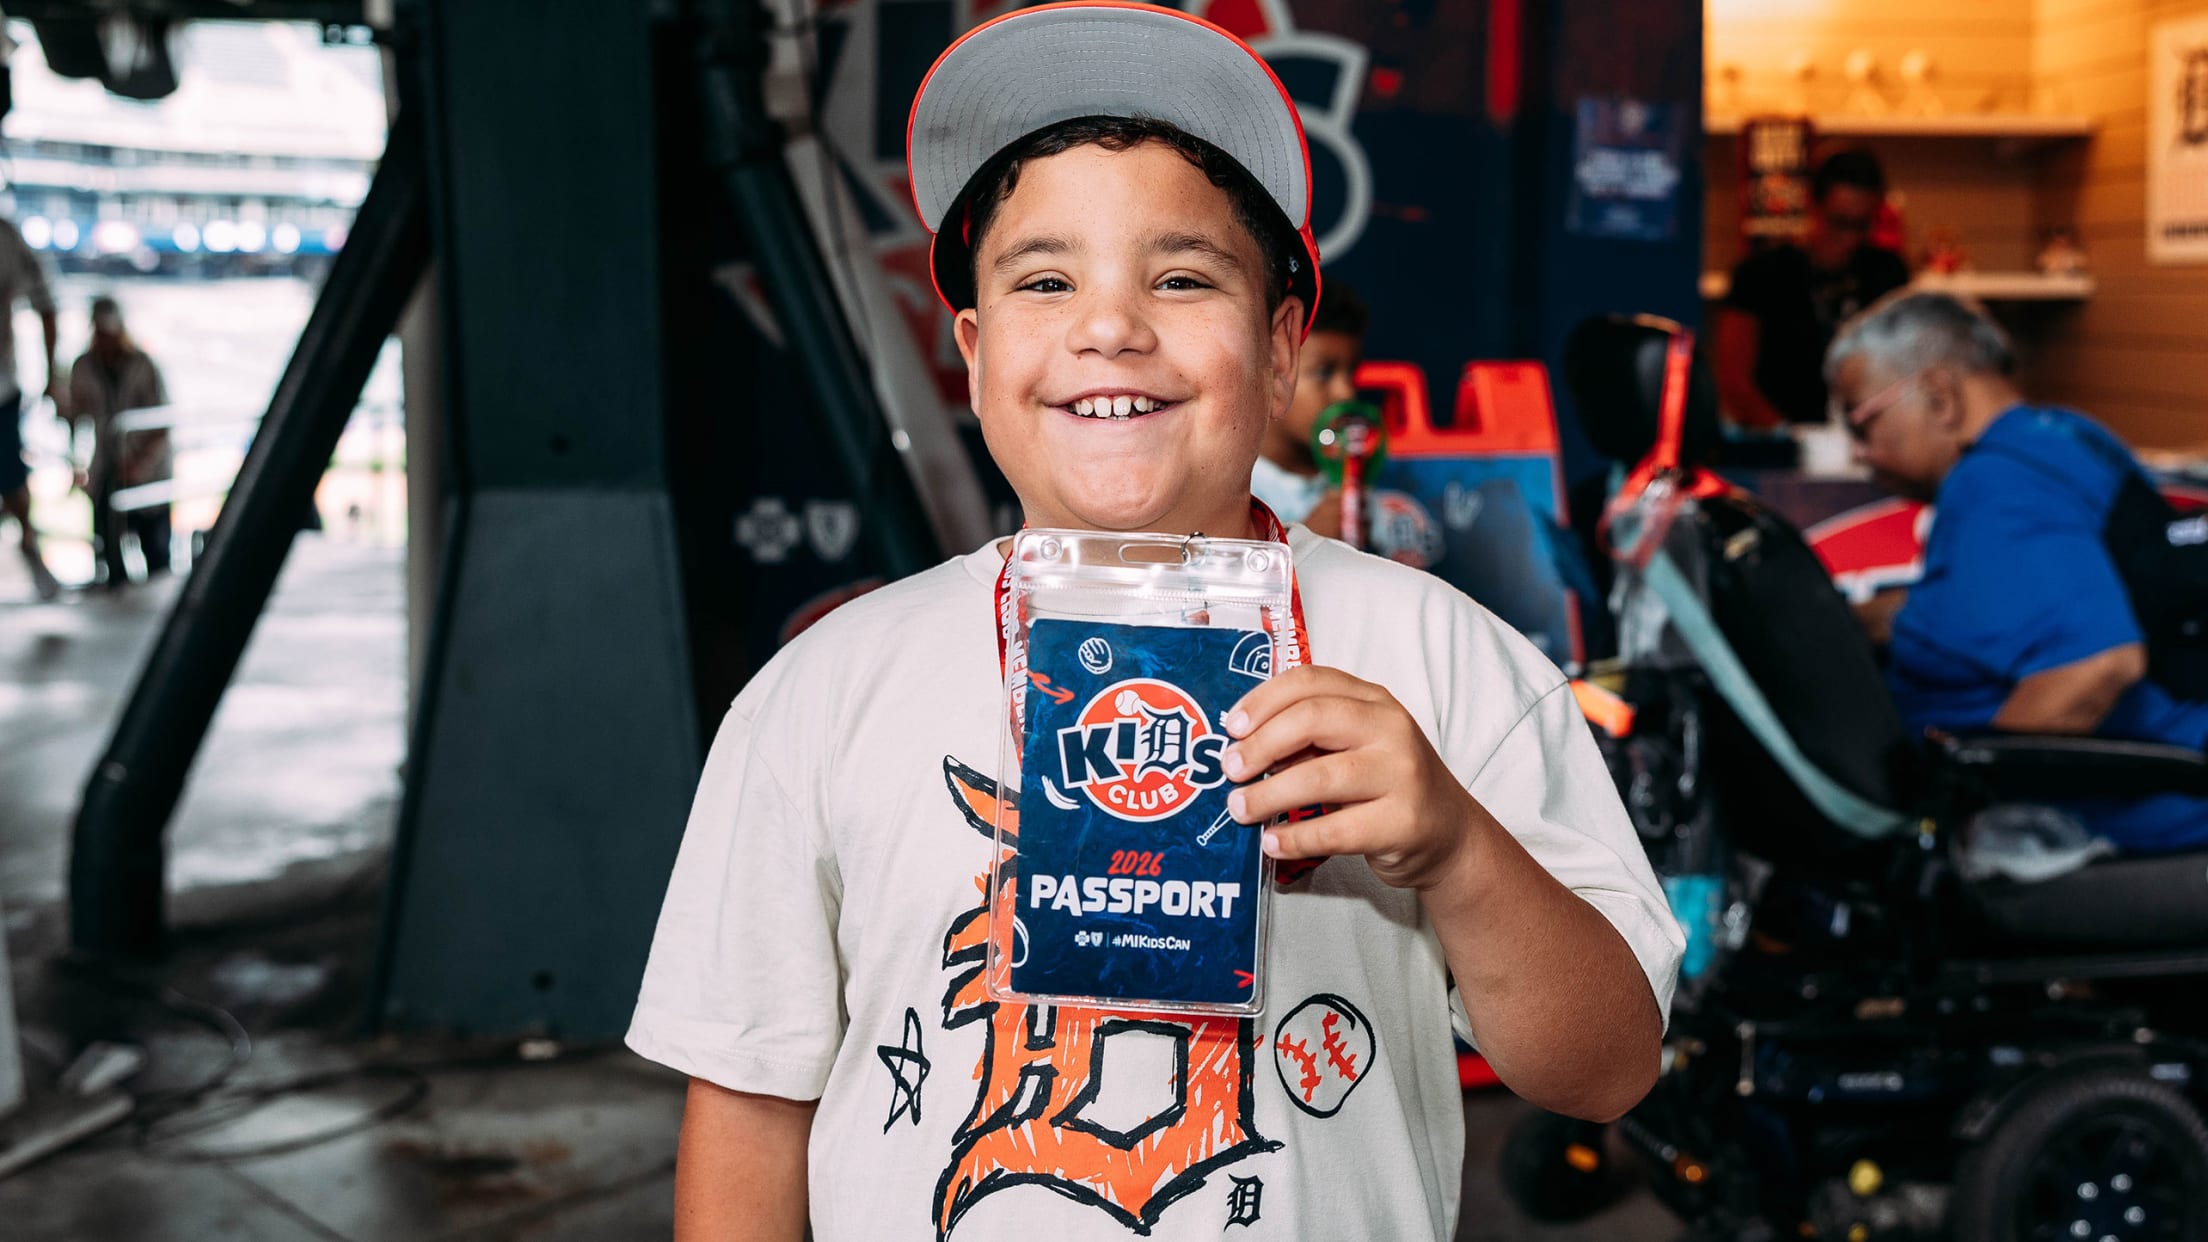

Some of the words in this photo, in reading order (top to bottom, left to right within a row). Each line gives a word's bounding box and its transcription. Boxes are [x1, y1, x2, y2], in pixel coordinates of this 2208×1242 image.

[1008, 639, 1028, 733] MEMBE
[1057, 700, 1230, 789] KIDS
[1108, 784, 1180, 811] CLUB
[1107, 850, 1164, 876] 2026
[1030, 874, 1240, 919] PASSPORT
